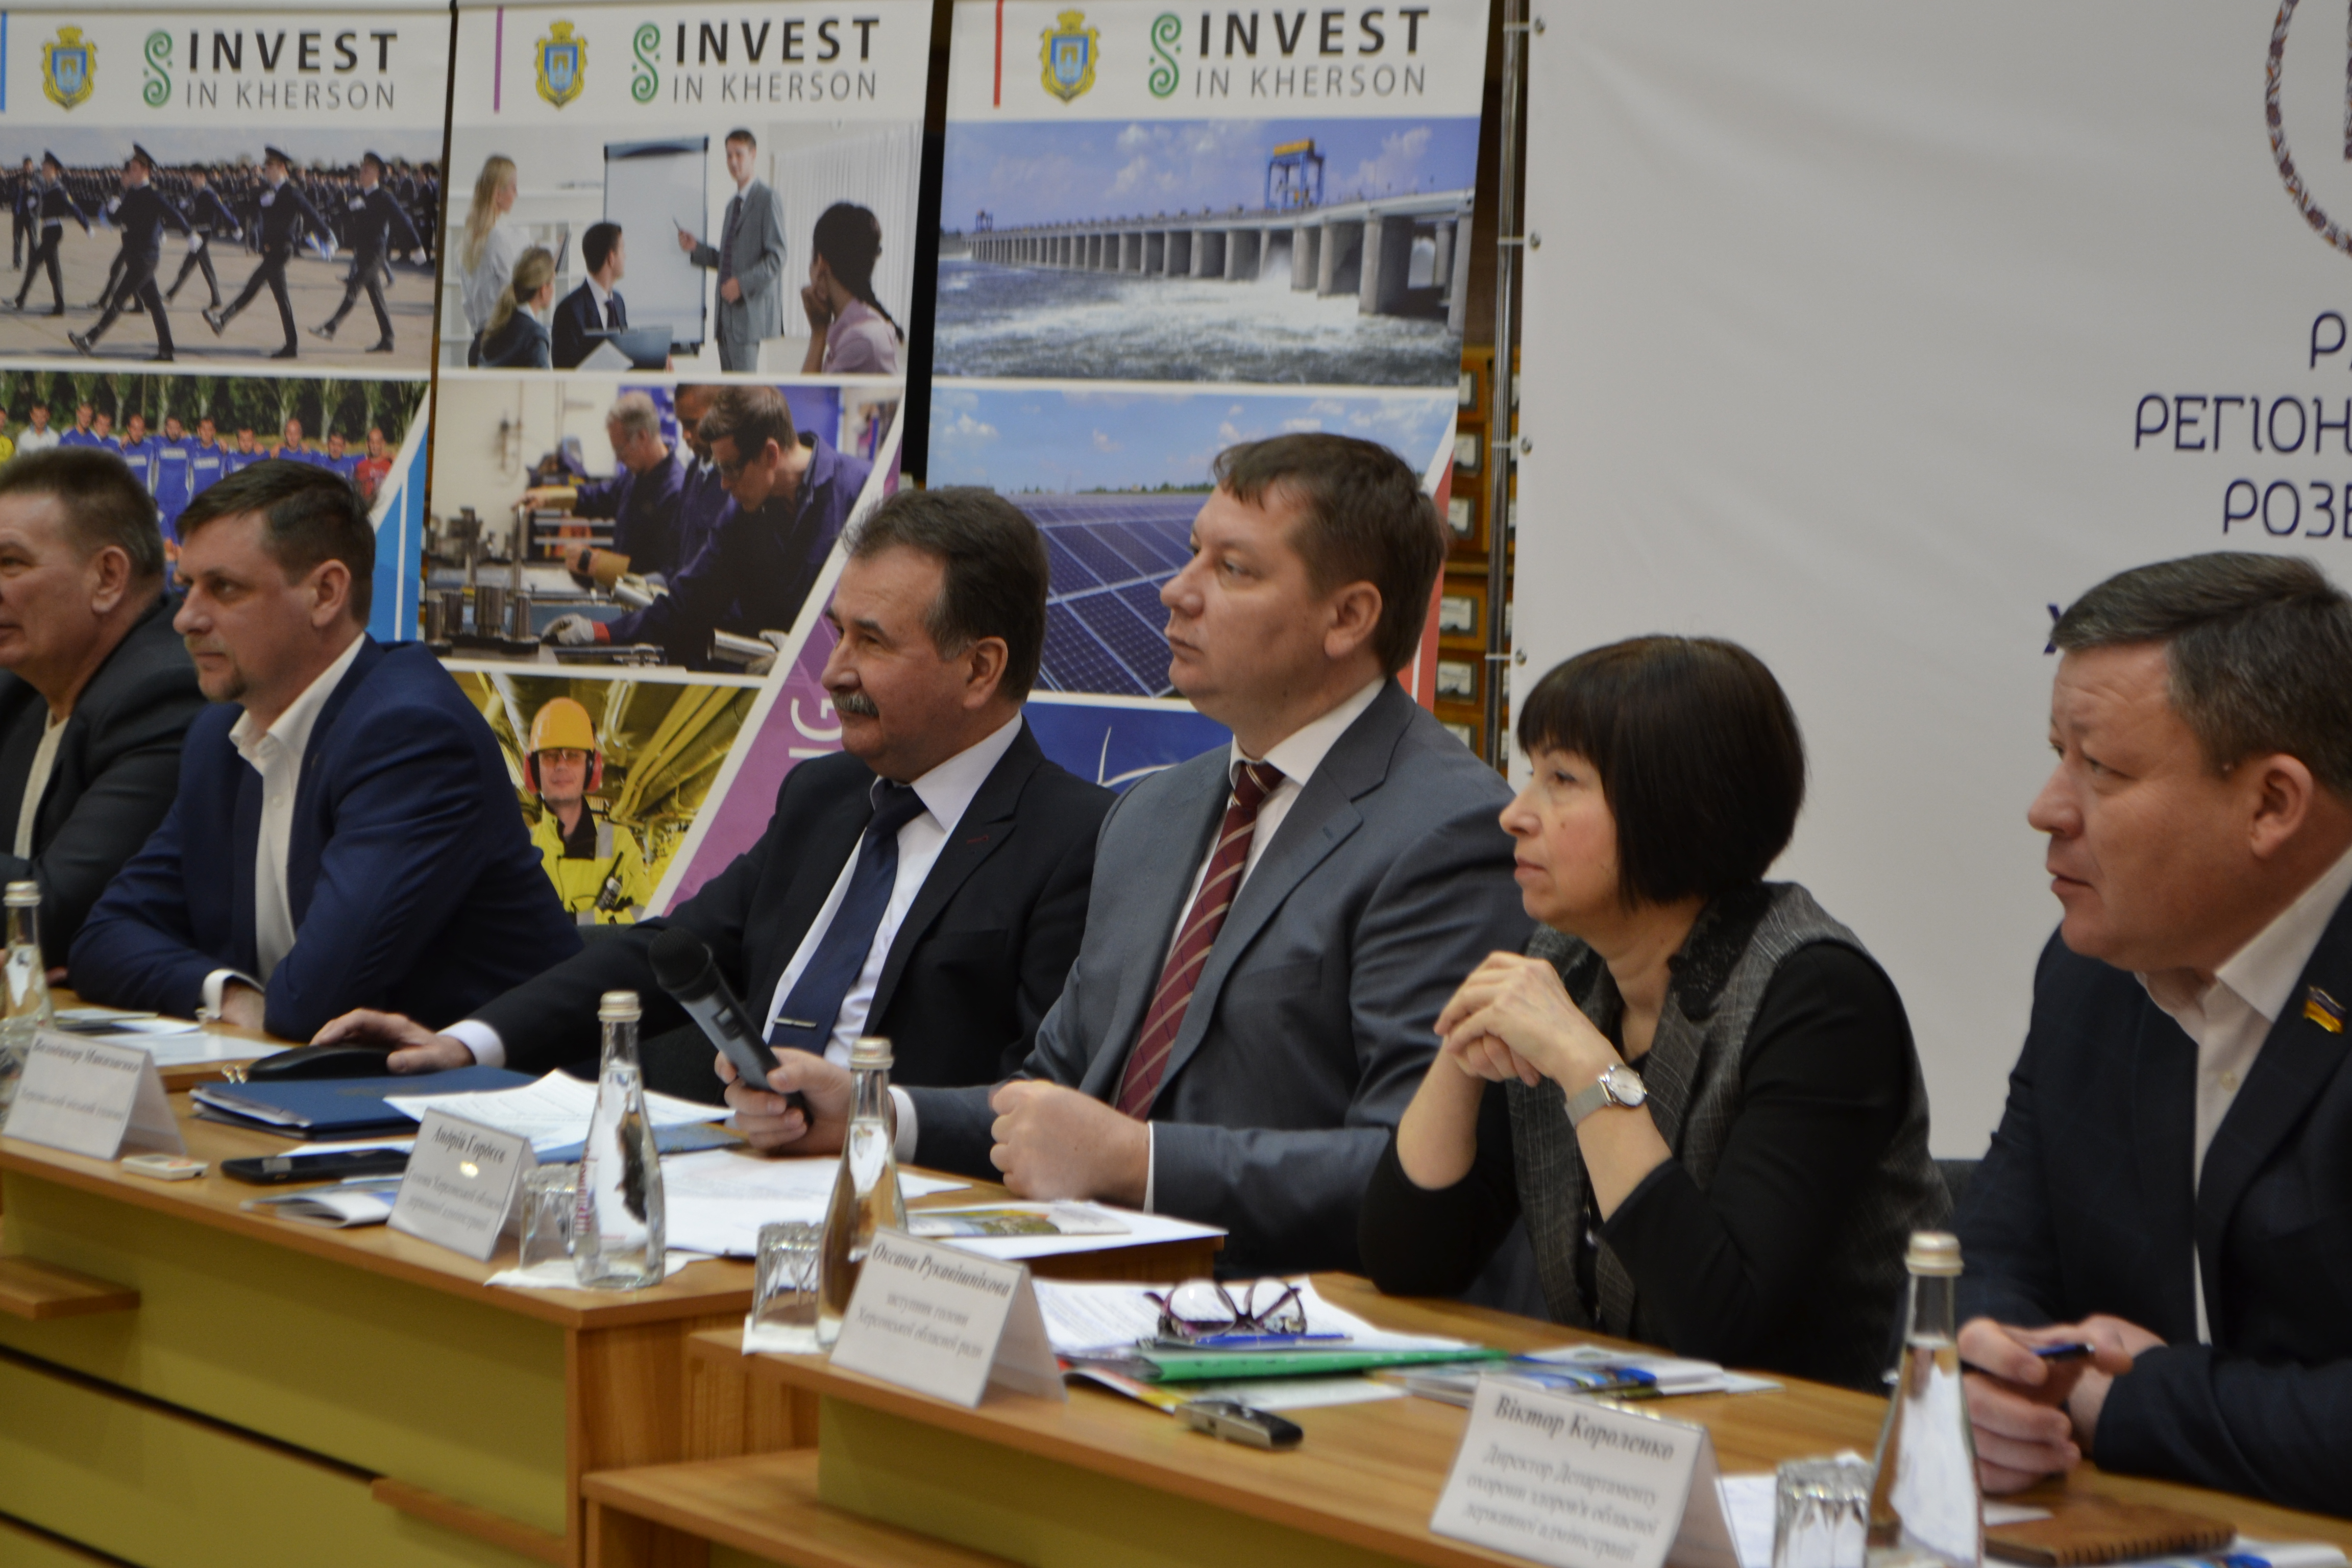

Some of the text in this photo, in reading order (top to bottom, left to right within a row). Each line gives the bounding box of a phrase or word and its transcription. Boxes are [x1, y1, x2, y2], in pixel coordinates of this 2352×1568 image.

[189, 30, 397, 72] INVEST
[677, 16, 879, 64] INVEST
[1199, 7, 1429, 57] INVEST
[187, 81, 394, 109] IN KHERSON
[674, 70, 875, 102] IN KHERSON
[1196, 65, 1424, 97] IN KHERSON
[2309, 310, 2352, 370] Р
[2223, 478, 2352, 539] РОЗ
[872, 1242, 1011, 1298] Оксана Рукавішнікова
[1495, 1394, 1674, 1460] Віктор Короленко
